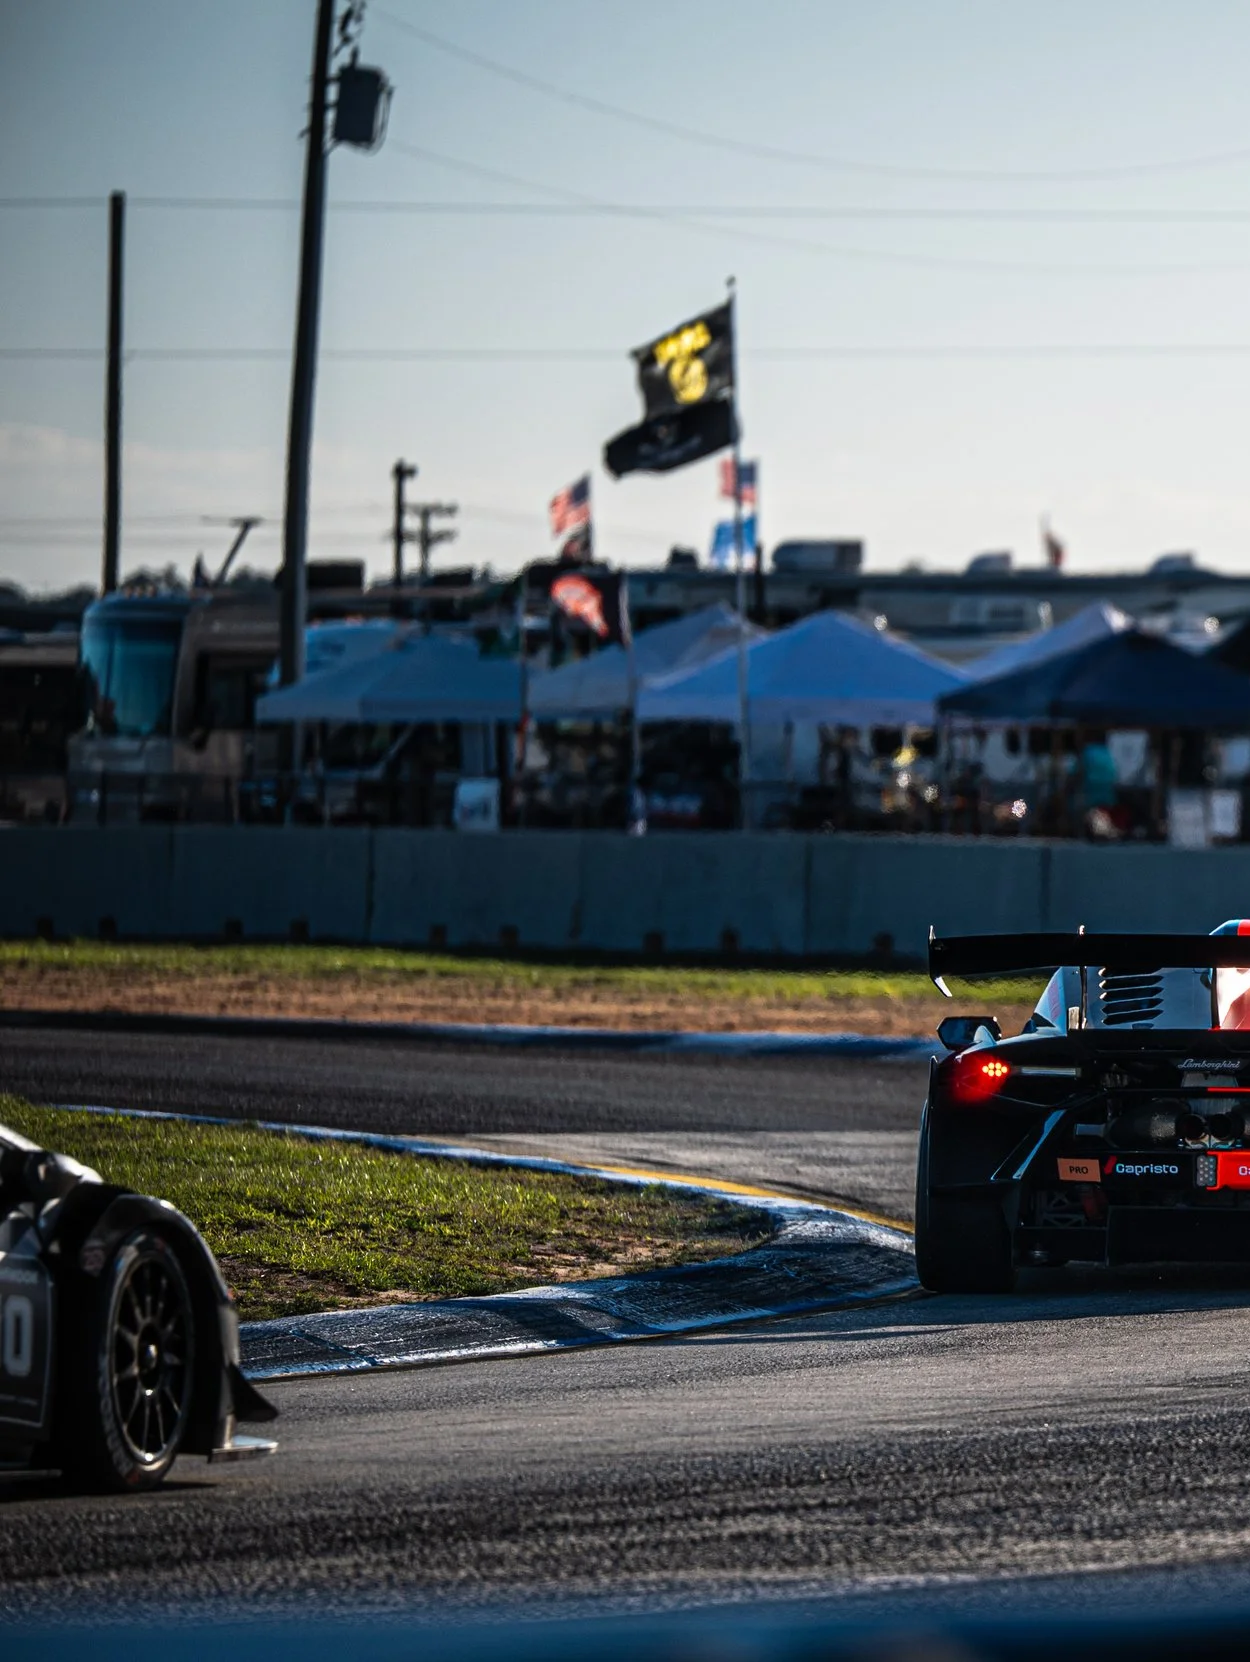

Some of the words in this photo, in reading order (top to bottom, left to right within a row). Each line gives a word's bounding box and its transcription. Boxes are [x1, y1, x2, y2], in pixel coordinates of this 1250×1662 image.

[1177, 1058, 1241, 1070] Lamborghini
[1069, 1166, 1089, 1174] PRO
[1115, 1163, 1178, 1175] Capristo
